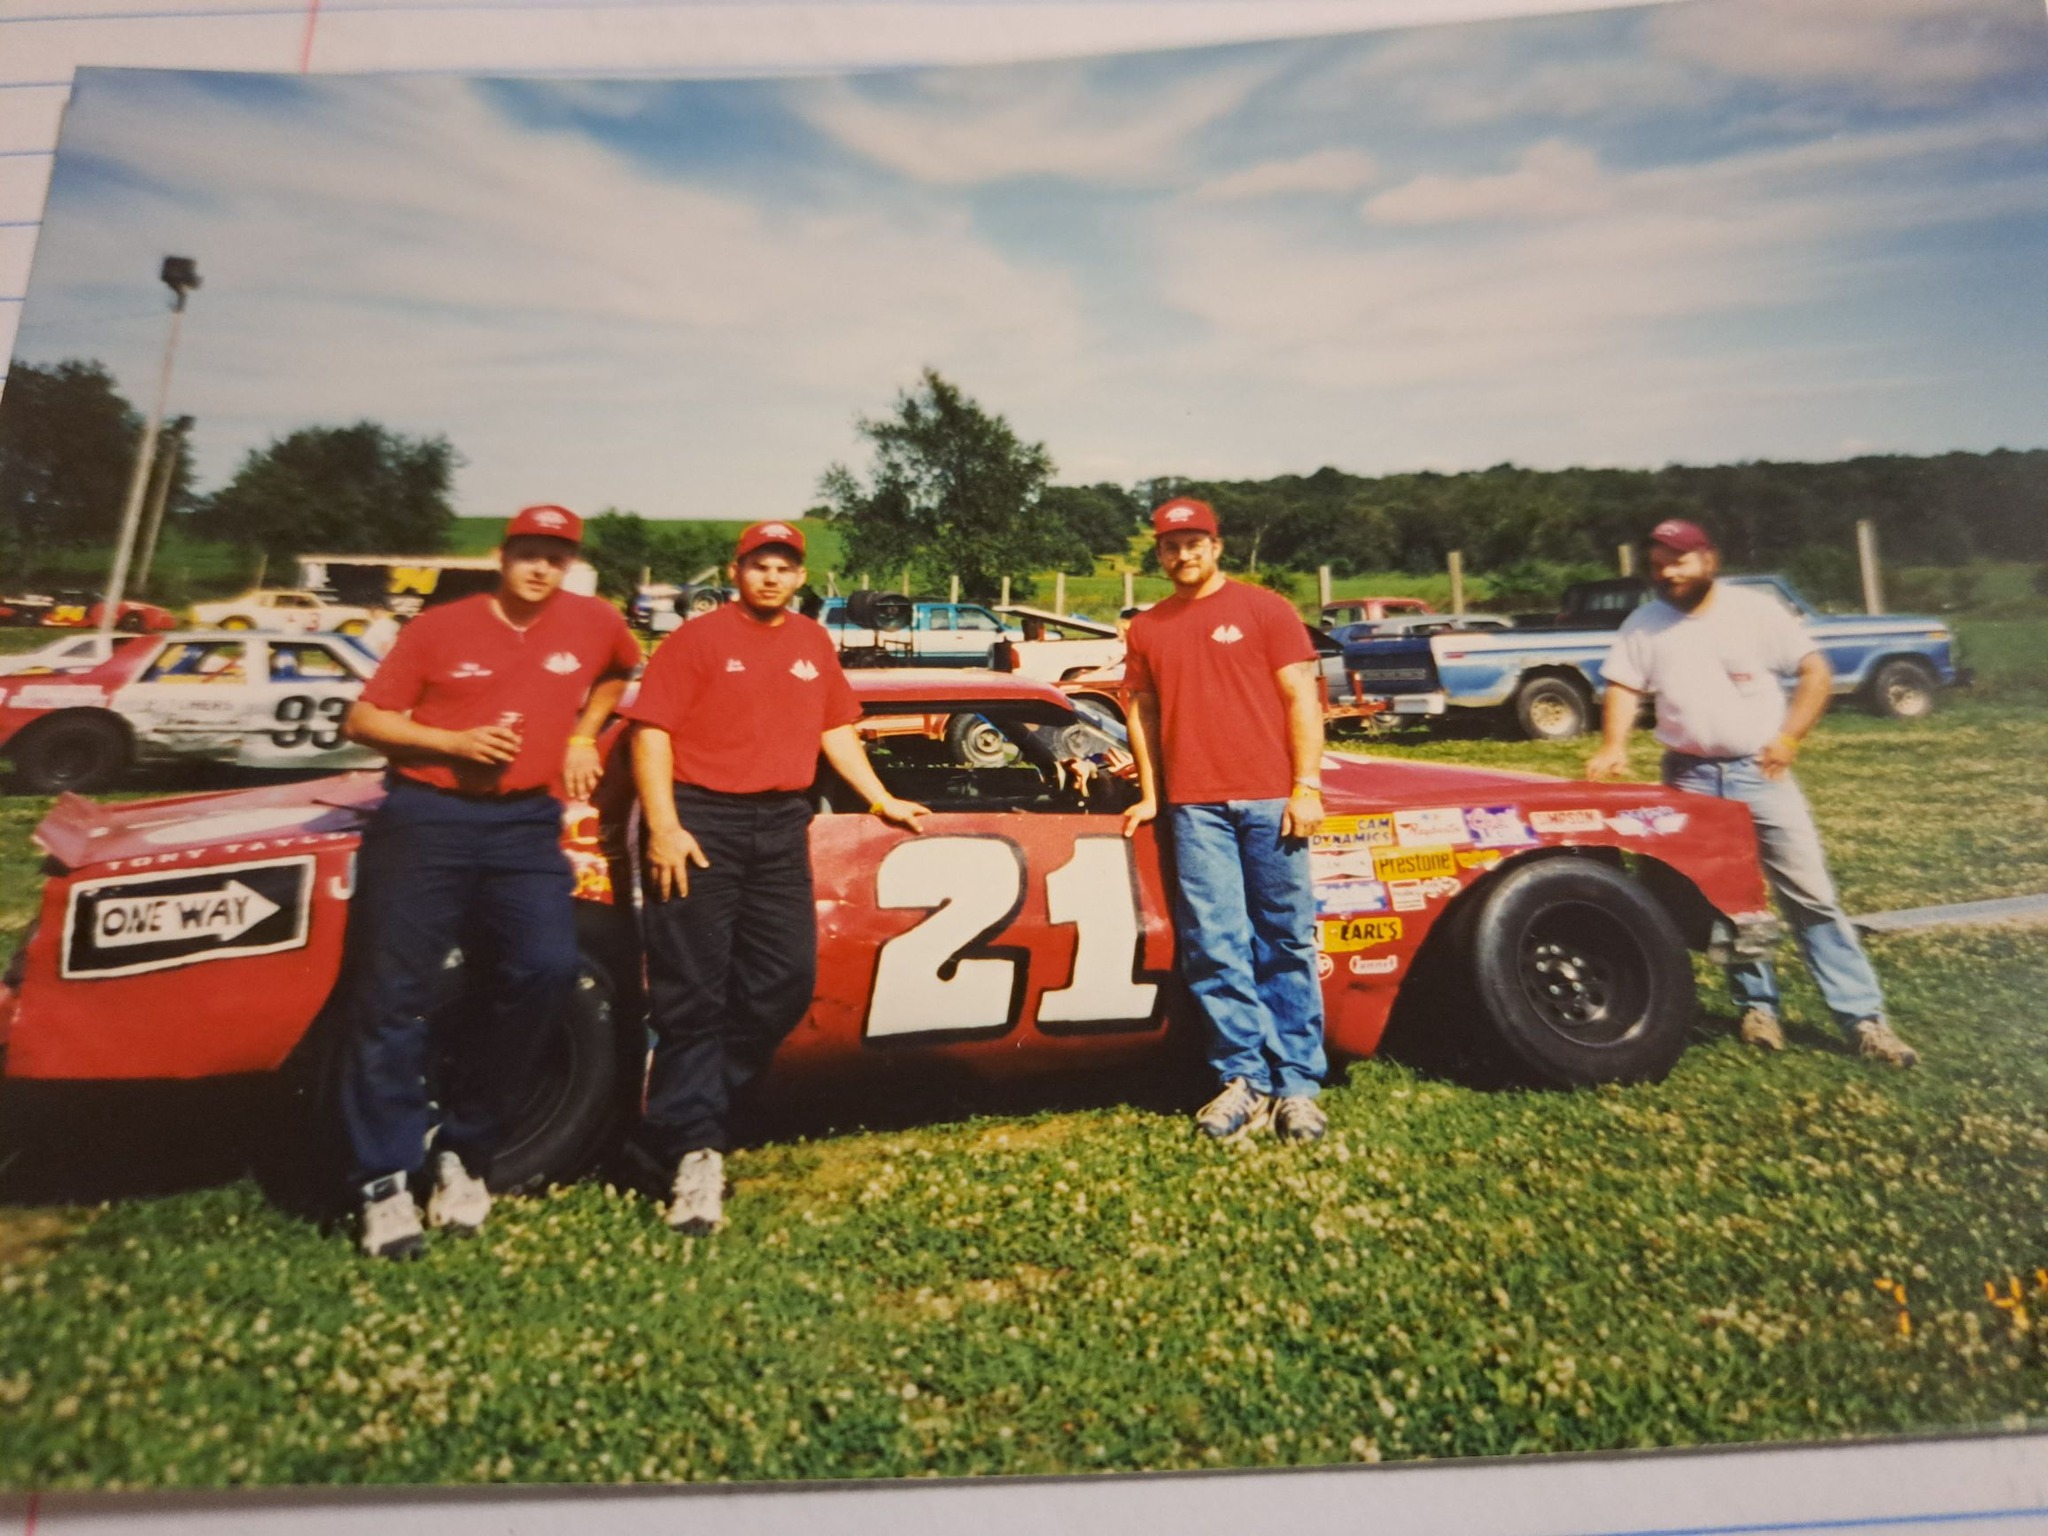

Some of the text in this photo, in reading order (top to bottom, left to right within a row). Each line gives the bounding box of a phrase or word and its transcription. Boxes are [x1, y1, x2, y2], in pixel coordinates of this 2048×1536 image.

[271, 694, 351, 750] 93
[1358, 818, 1390, 831] CAM
[1532, 811, 1594, 826] SIMPSON
[1312, 831, 1390, 846] DYNAMICS
[1378, 852, 1452, 876] Prestone
[102, 896, 250, 937] ONE WAY
[863, 835, 1160, 1042] 21
[1340, 921, 1397, 941] EARL'S
